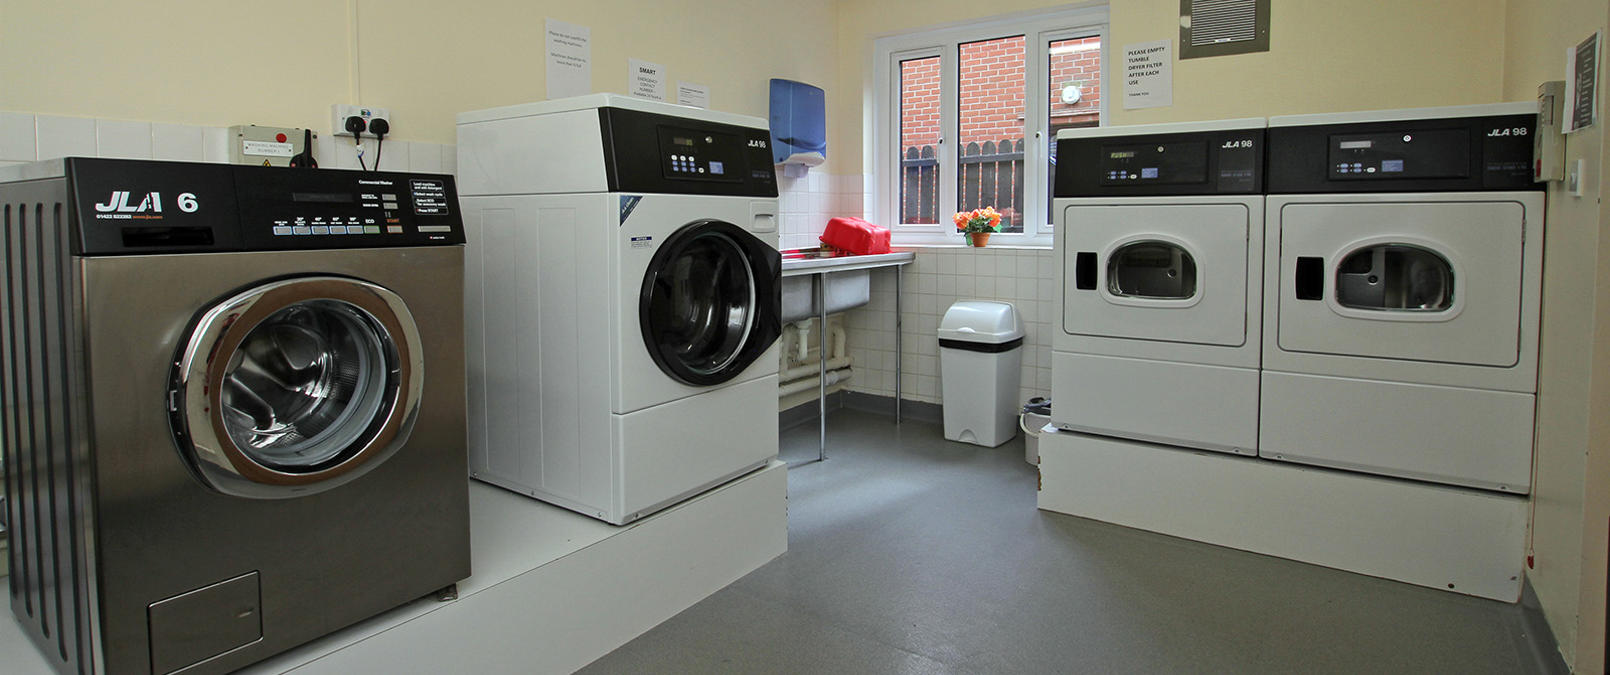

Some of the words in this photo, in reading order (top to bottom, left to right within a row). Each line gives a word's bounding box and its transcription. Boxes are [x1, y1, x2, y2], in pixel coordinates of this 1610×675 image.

[639, 67, 656, 75] SMART
[1487, 128, 1510, 136] JLA
[1512, 127, 1527, 136] 98
[95, 191, 162, 212] JLA
[177, 192, 199, 213] 6
